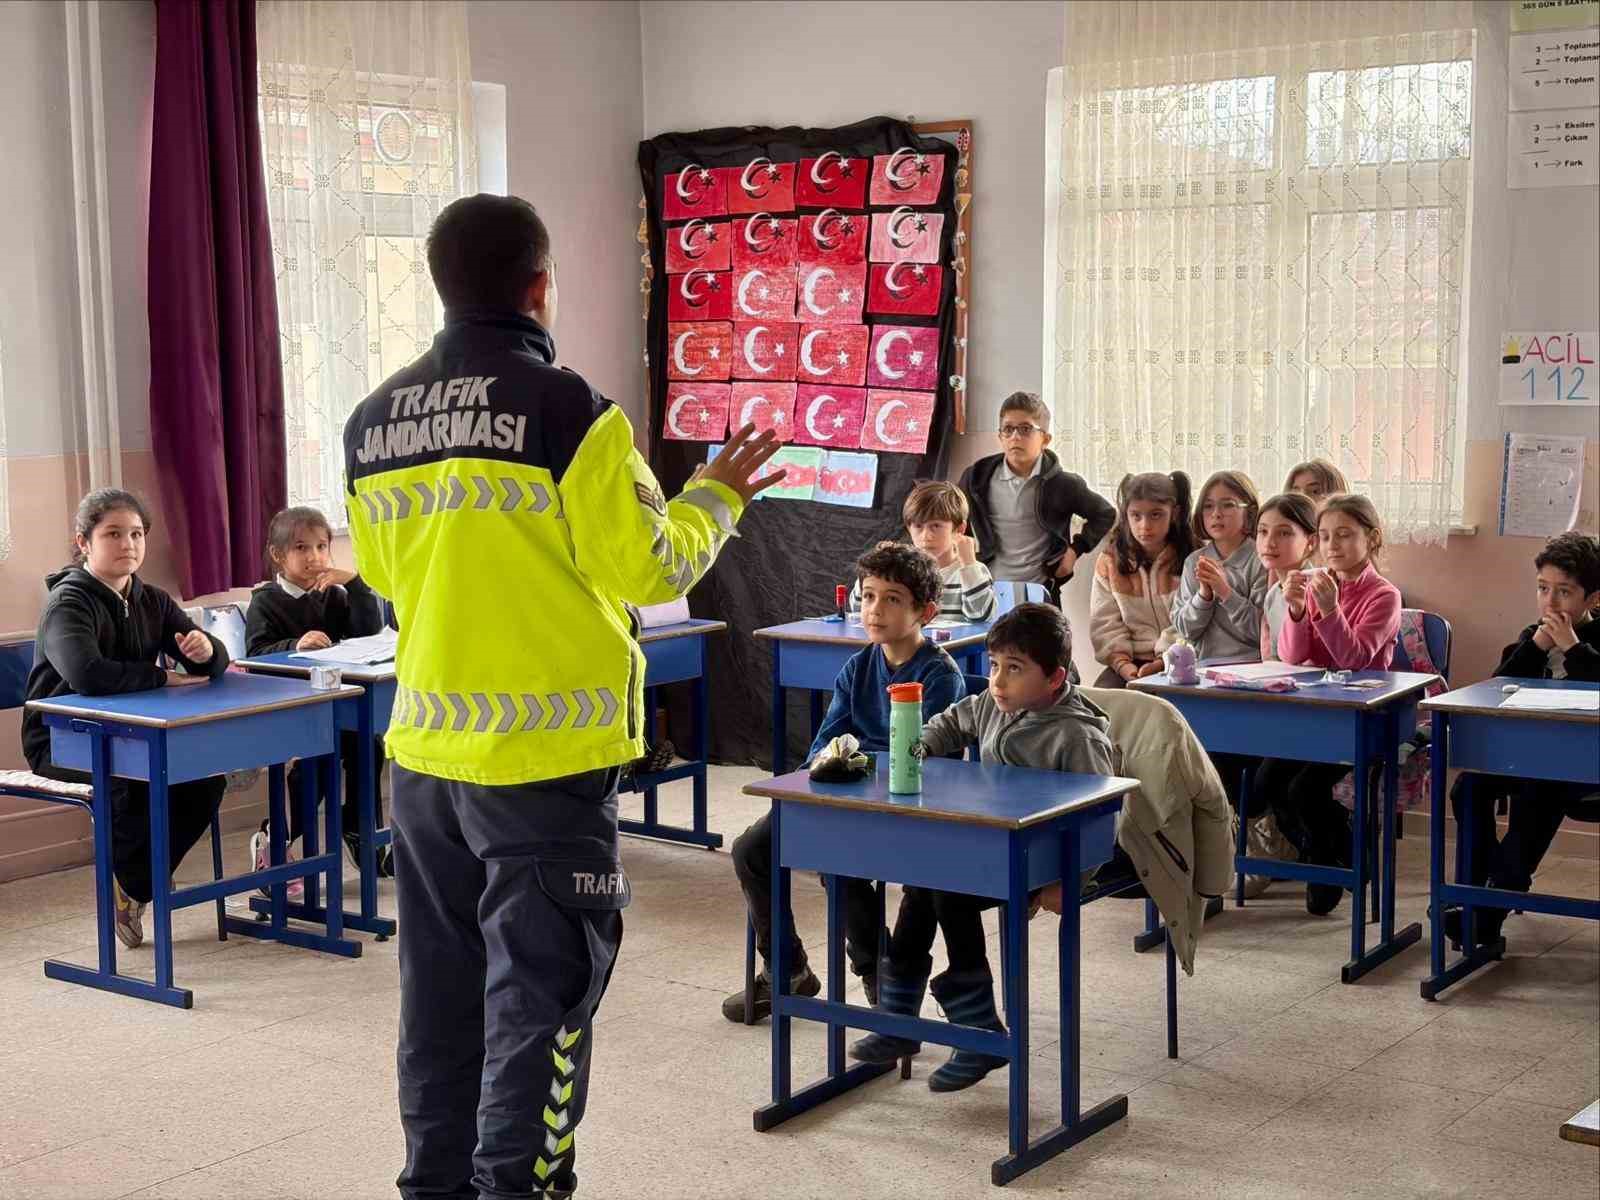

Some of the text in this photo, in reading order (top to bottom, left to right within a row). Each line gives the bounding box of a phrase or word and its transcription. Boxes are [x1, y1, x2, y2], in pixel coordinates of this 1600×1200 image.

[1564, 76, 1595, 85] Toplam
[390, 376, 497, 419] TRAFİK
[356, 410, 527, 464] JANDARMASI
